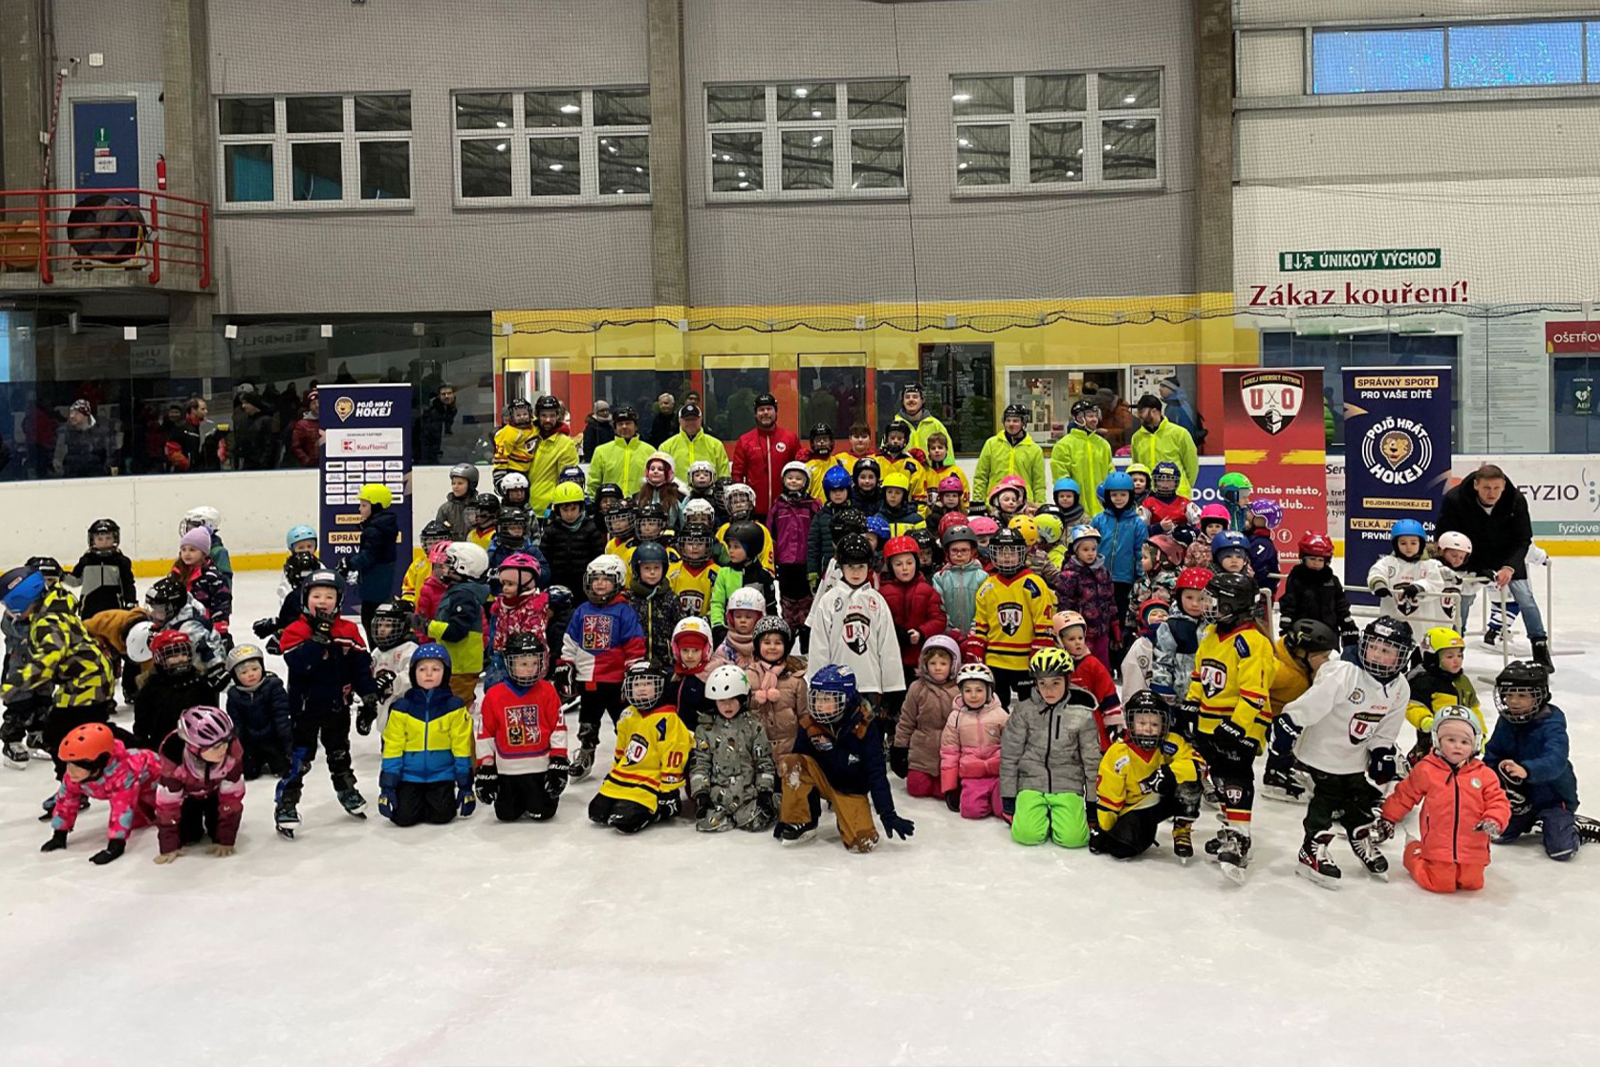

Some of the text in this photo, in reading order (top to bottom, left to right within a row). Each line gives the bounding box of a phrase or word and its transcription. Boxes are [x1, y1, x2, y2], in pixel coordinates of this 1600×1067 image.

[1319, 250, 1436, 269] ÚNIKOVÝ VÝCHOD
[1249, 281, 1468, 306] Zákaz kouření!
[1357, 378, 1436, 387] SPRÁVNÝ SPORT
[1360, 389, 1432, 399] PRO VAŠE DÍTĚ
[355, 407, 392, 417] HOKEJ
[1366, 416, 1429, 440] POJĎ HRÁT
[356, 443, 389, 451] Kaufland
[1369, 463, 1424, 485] HOKEJ
[1256, 485, 1282, 495] naše
[1285, 485, 1322, 497] město,
[1516, 485, 1579, 501] FYZIO
[1279, 498, 1315, 510] klub...
[1352, 519, 1380, 528] VELKÁ
[331, 533, 360, 542] SPRÁV
[335, 545, 352, 554] PRO
[667, 751, 684, 768] 10
